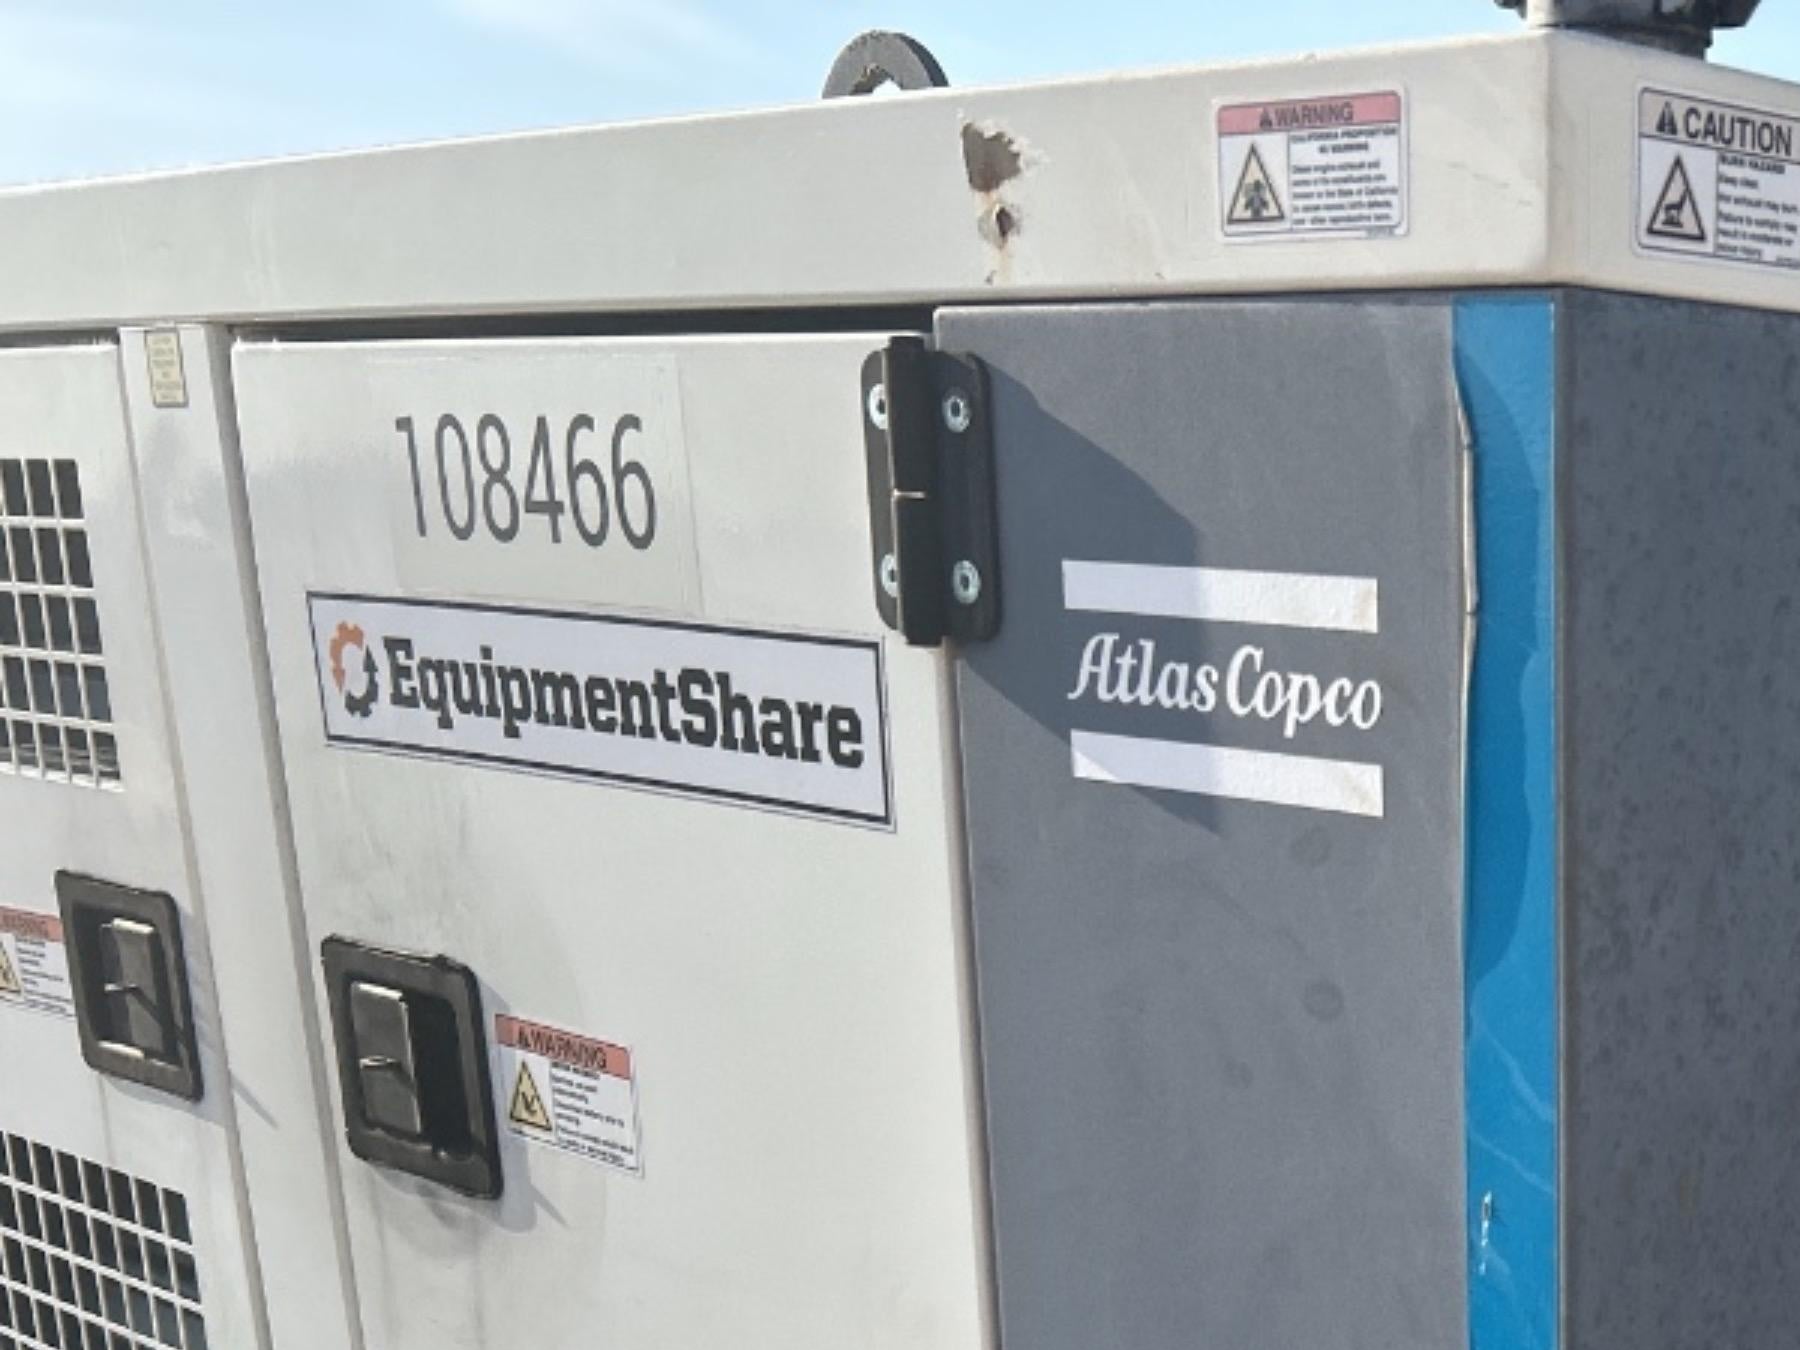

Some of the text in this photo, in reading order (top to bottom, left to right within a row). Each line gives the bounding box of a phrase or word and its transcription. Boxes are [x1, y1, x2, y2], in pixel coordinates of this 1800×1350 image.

[1275, 103, 1353, 126] WARNING
[1684, 107, 1792, 156] CAUTION
[395, 413, 655, 550] 108466
[382, 635, 864, 769] EquipmentShare
[1067, 632, 1382, 738] Atlas Copco
[530, 1027, 606, 1069] WARNING
